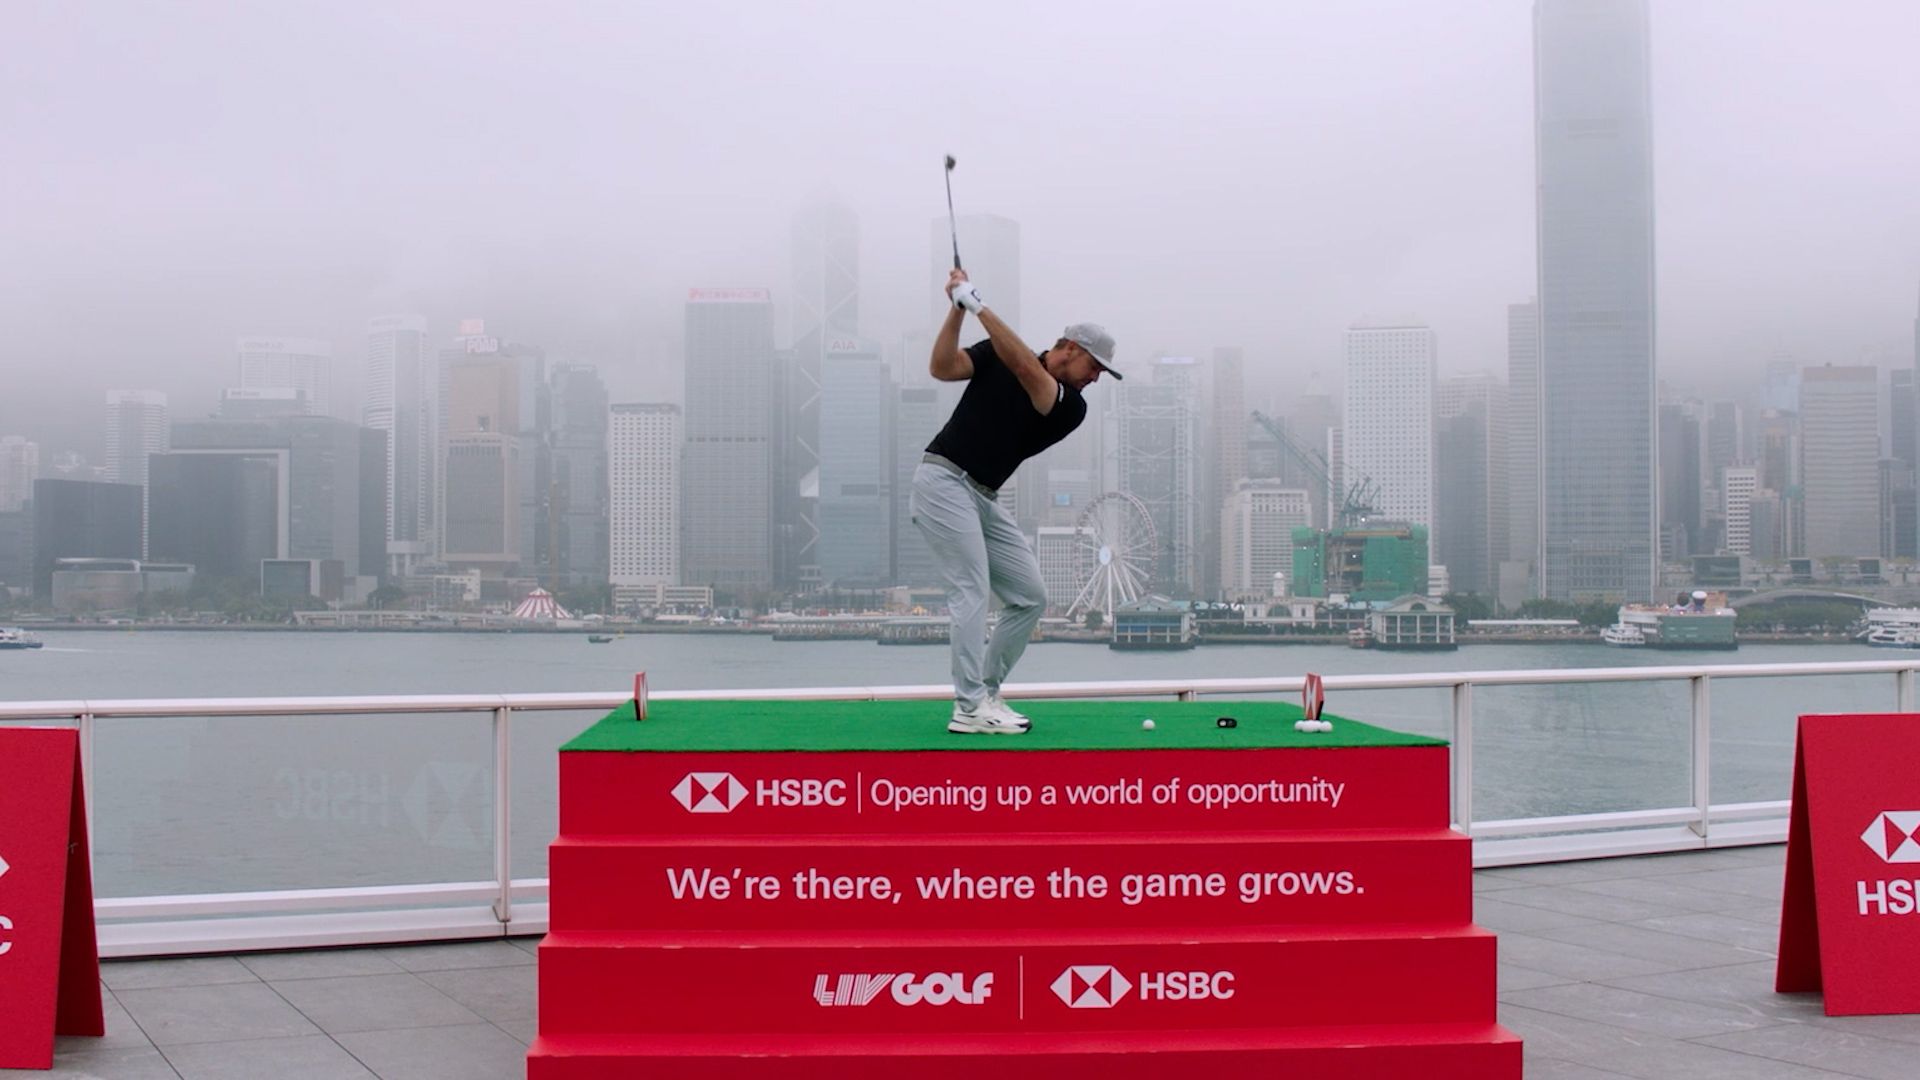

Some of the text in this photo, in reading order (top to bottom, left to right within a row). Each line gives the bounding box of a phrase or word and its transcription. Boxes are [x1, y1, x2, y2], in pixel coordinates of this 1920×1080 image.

[831, 340, 857, 351] AIA
[756, 779, 847, 807] HSBC
[870, 776, 1345, 812] Opening up a world of opportunity
[792, 868, 902, 904] there,
[916, 868, 1035, 900] where
[1046, 867, 1108, 899] the
[1121, 873, 1226, 905] game
[1238, 871, 1364, 903] grows.
[1856, 879, 1920, 915] HS
[1140, 970, 1235, 1000] HSBC
